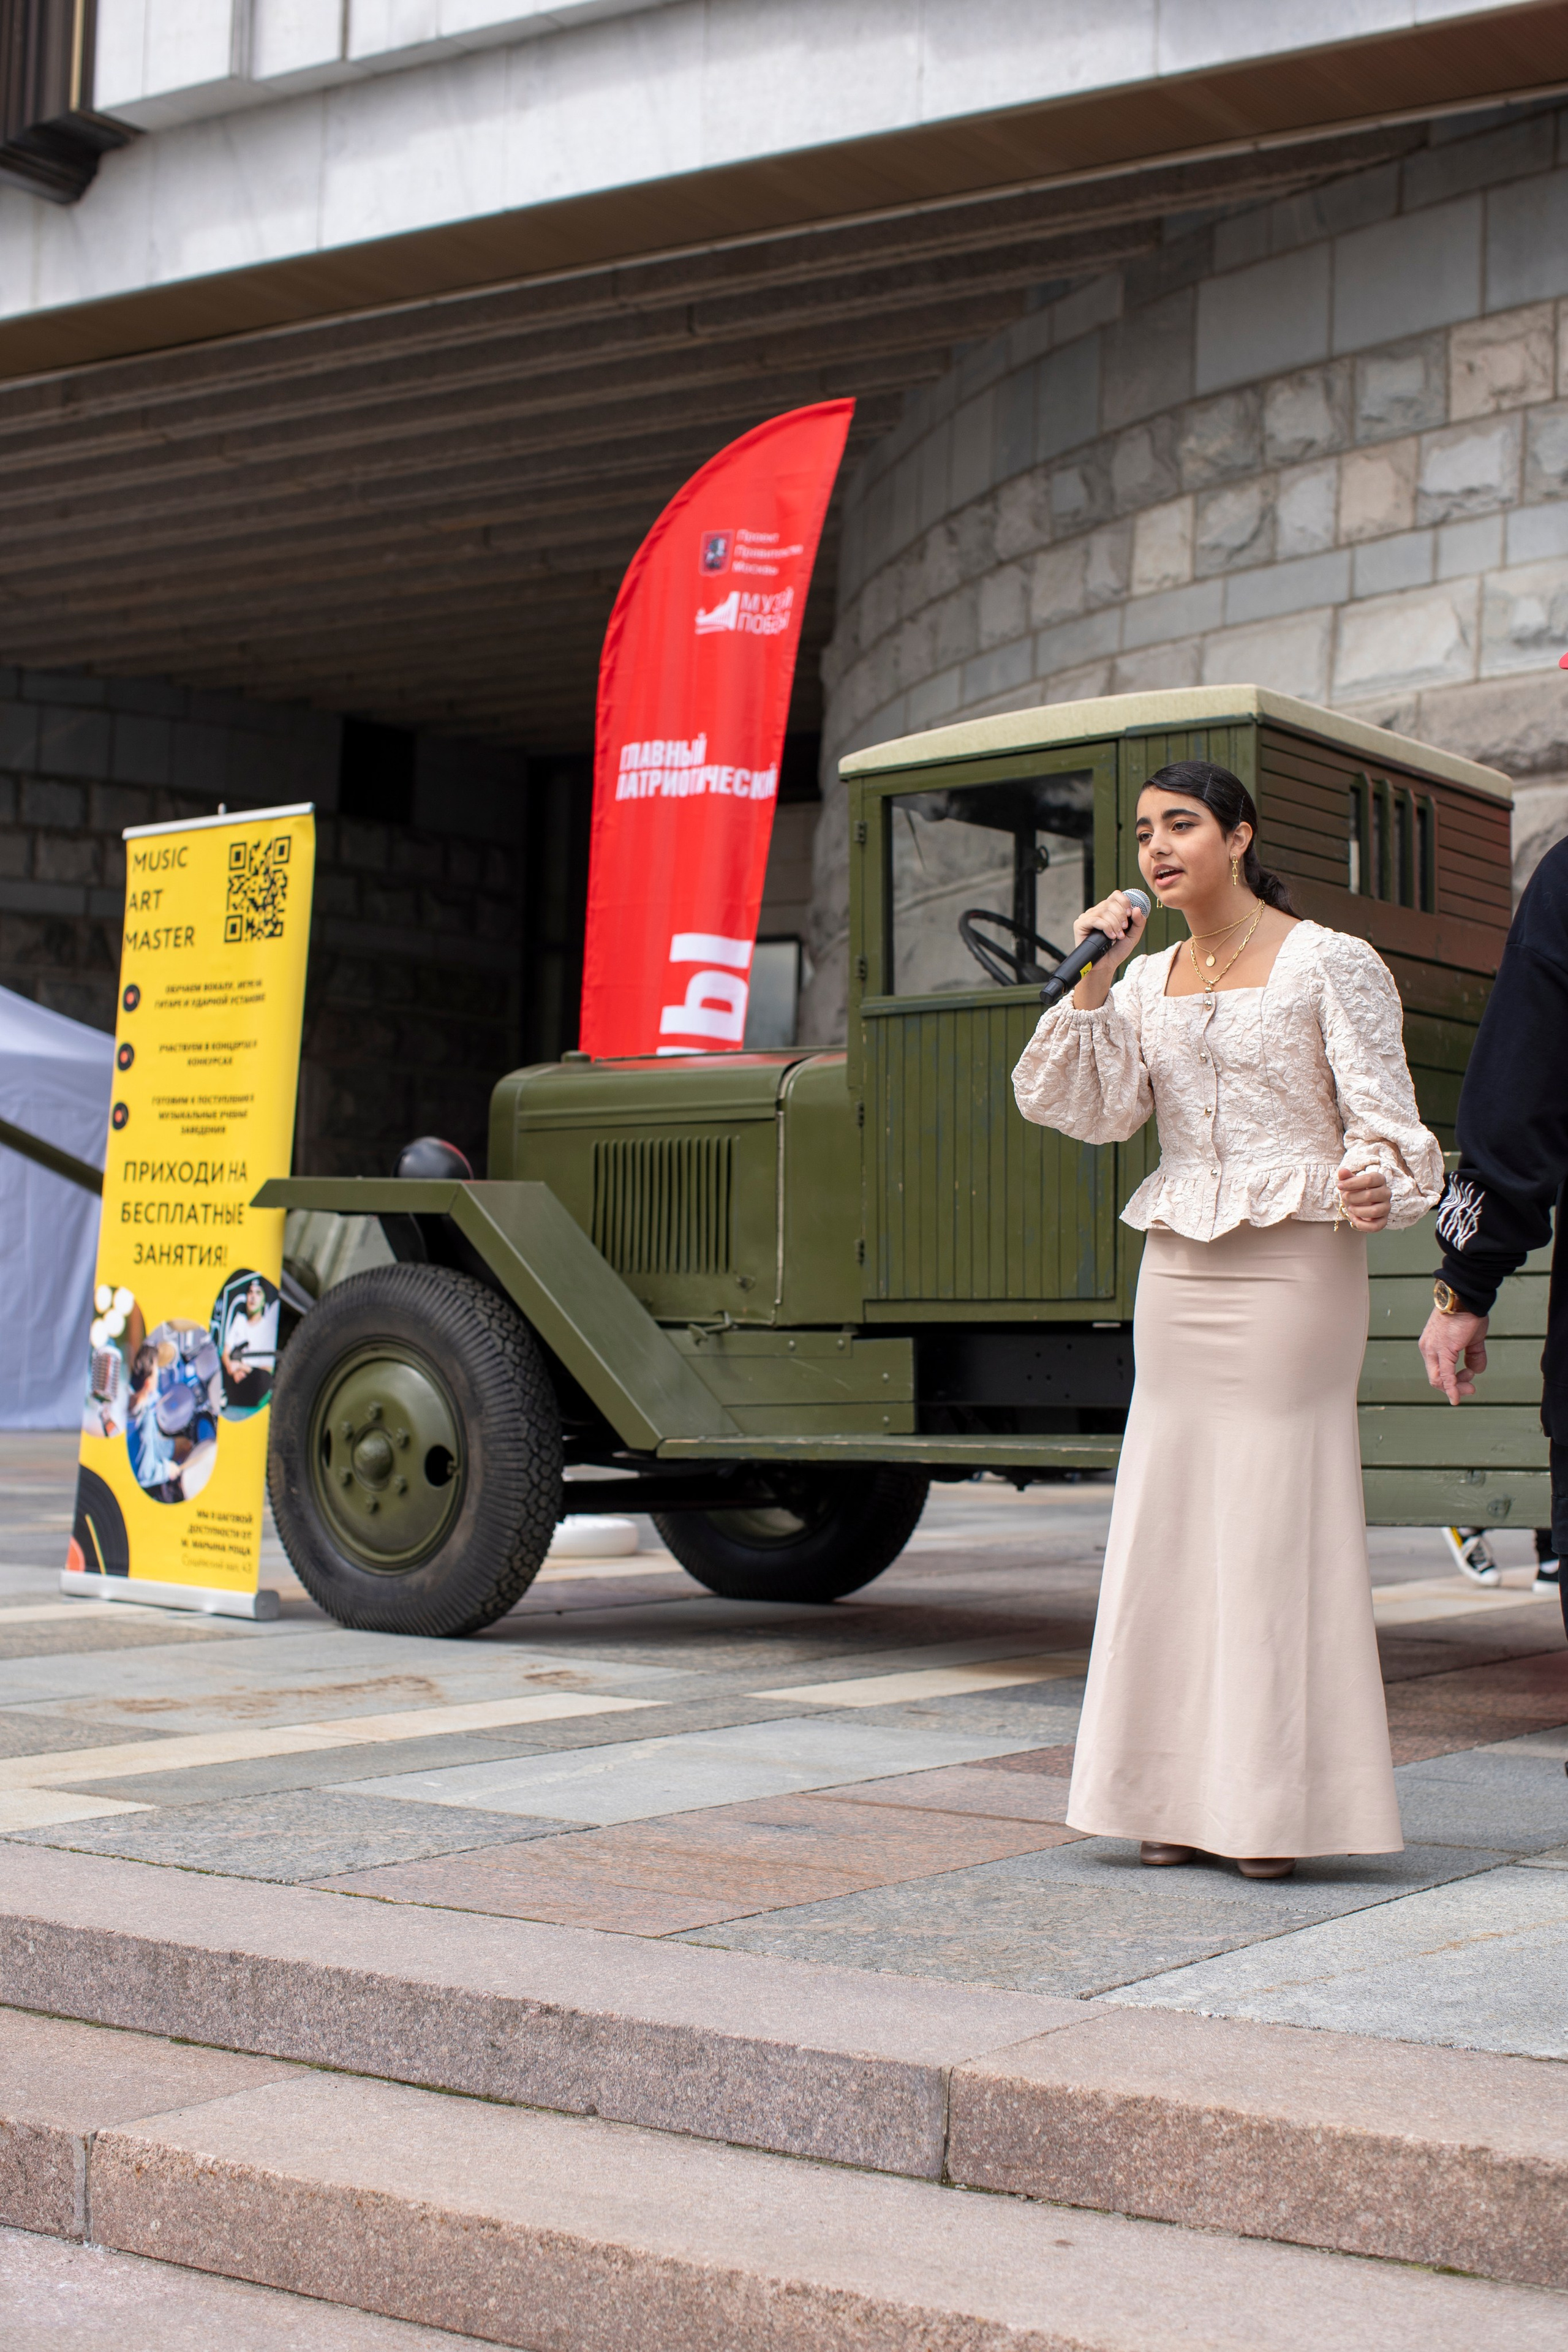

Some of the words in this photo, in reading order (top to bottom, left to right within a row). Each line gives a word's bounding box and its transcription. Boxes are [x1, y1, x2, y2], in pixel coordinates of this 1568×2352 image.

[131, 846, 189, 873] MUSIC
[127, 889, 164, 912] ART
[124, 925, 195, 951] MASTER
[124, 1161, 224, 1186] ПРИХОДИ
[228, 1160, 247, 1182] НА
[121, 1201, 245, 1225] БЕСПЛАТНЫЕ
[133, 1242, 228, 1267] ЗАНЯТИЯ!
